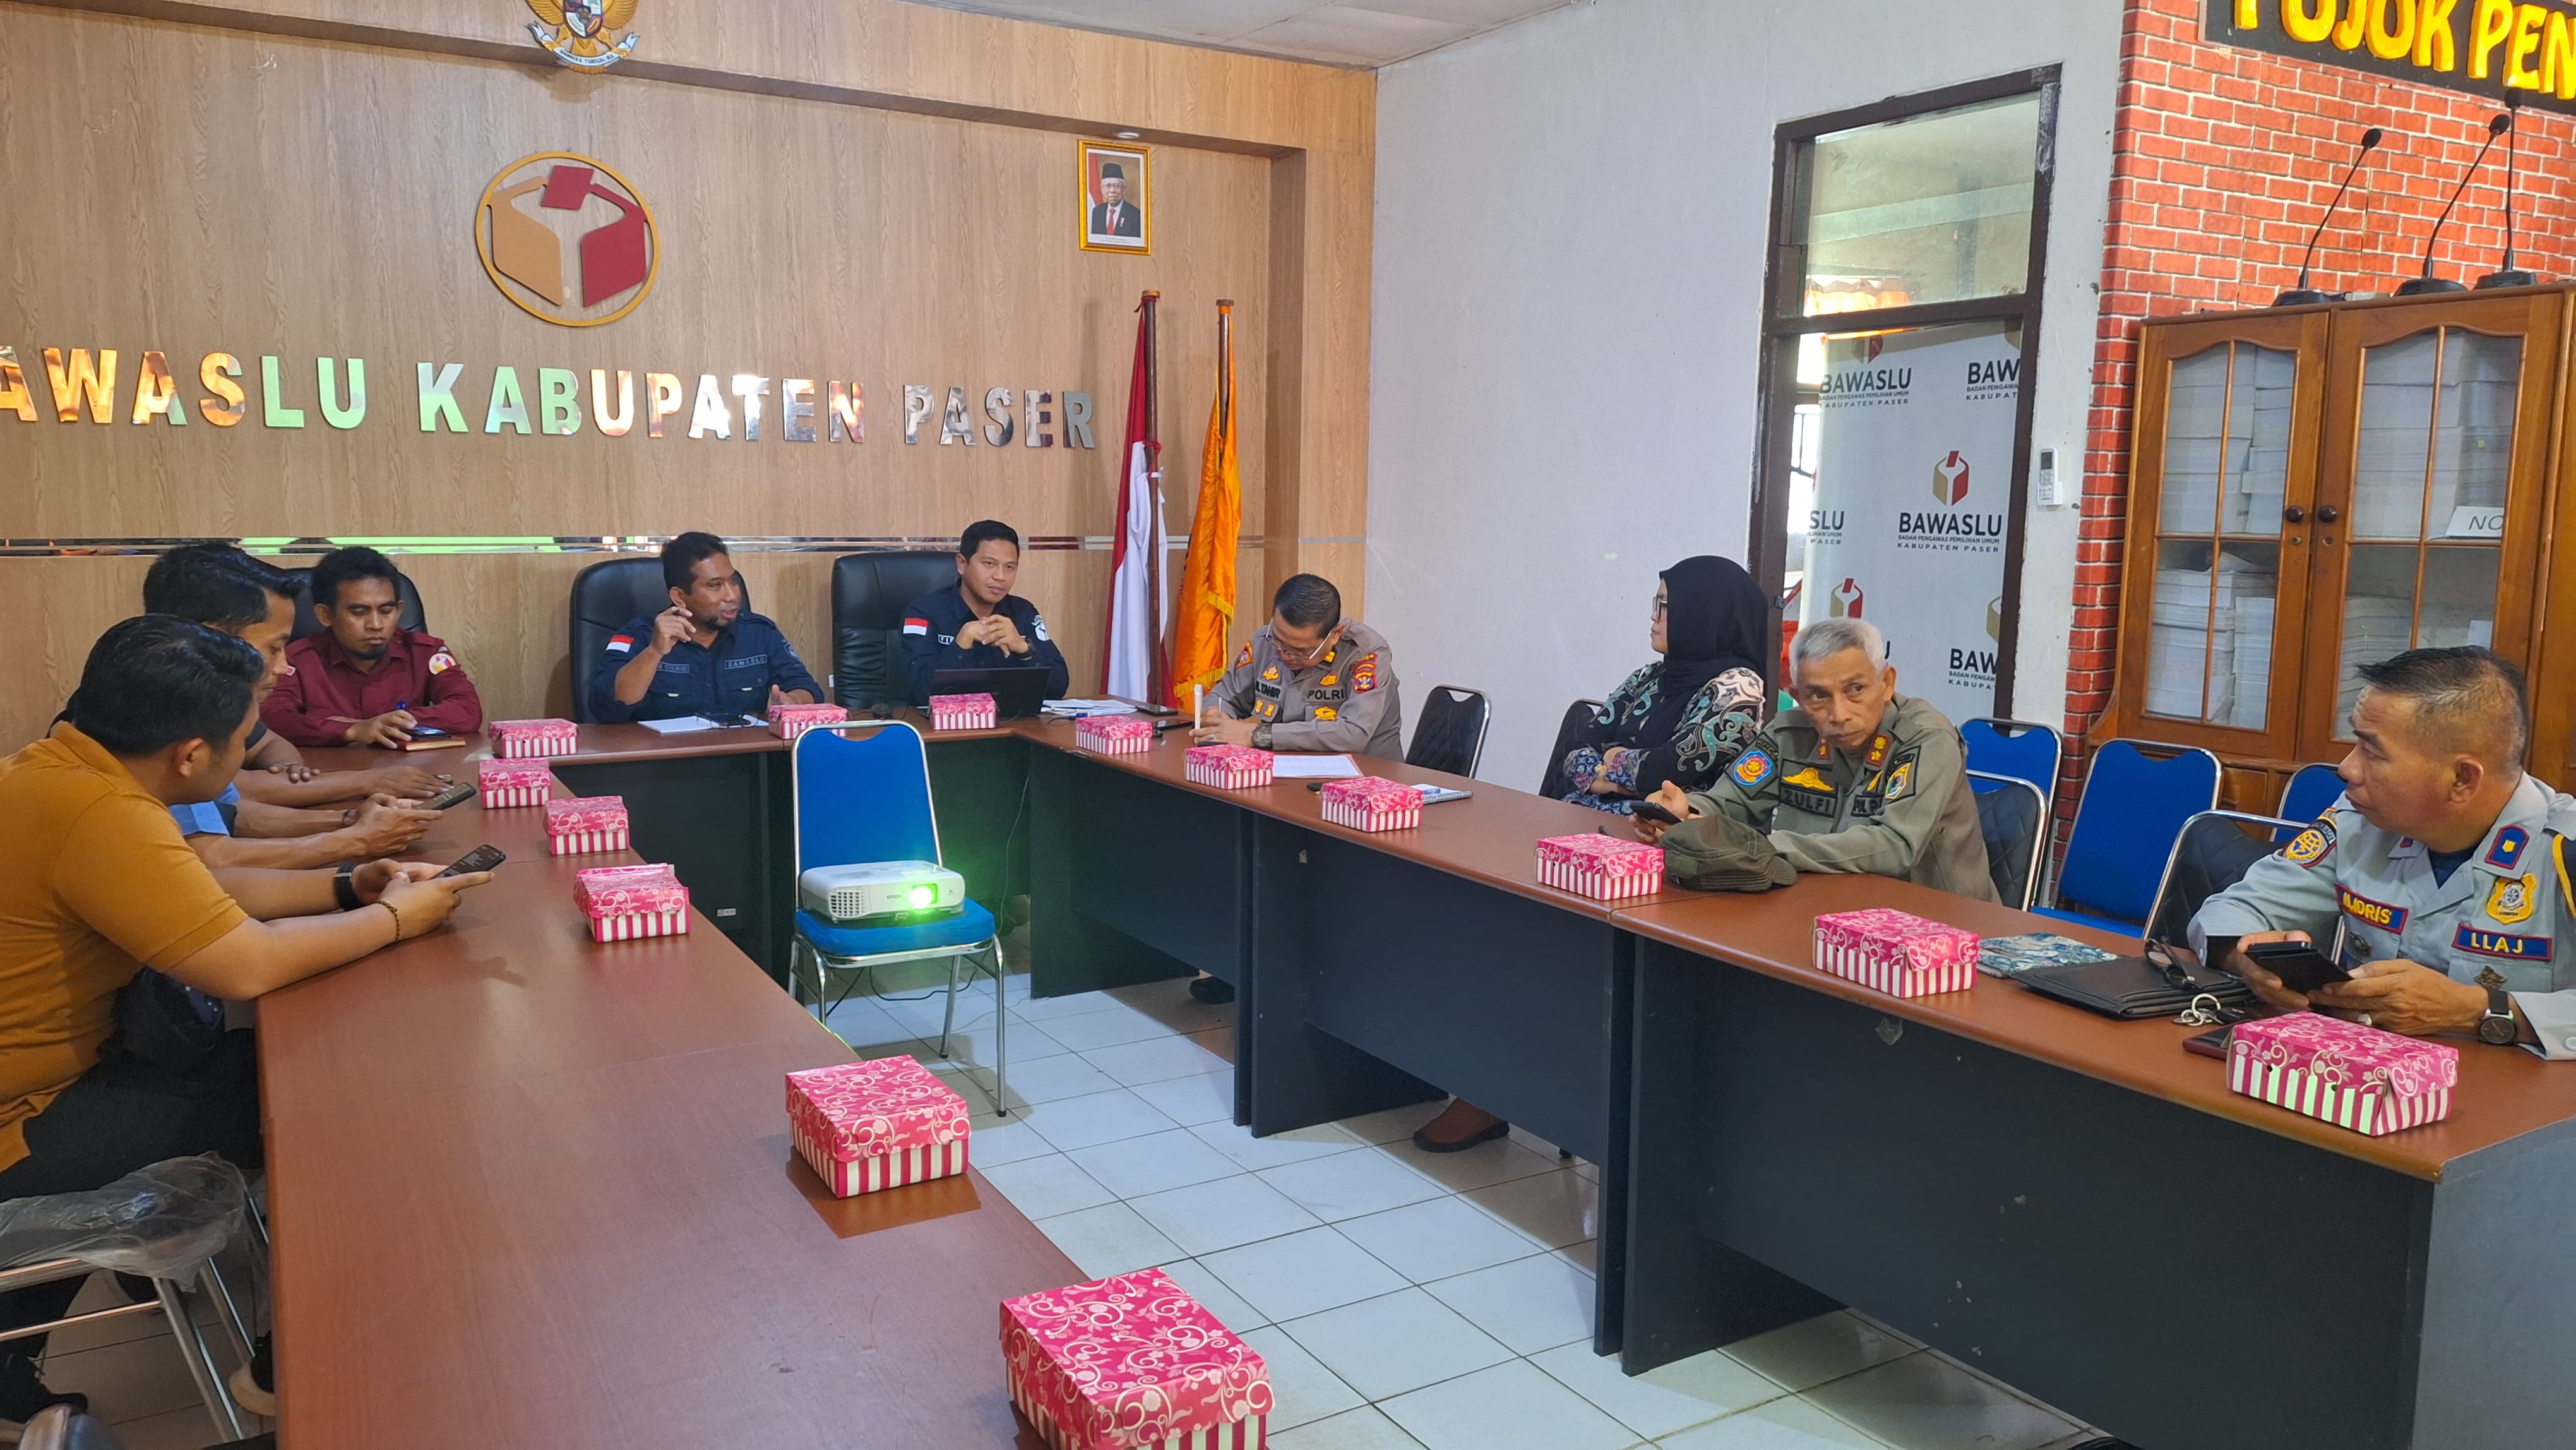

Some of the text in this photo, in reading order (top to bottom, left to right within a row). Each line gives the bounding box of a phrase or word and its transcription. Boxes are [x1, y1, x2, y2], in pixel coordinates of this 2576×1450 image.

[1820, 368, 1912, 393] BAWASLU
[1967, 358, 2020, 384] BAW
[417, 362, 865, 443] KABUPATEN
[903, 384, 1095, 449] PASER
[1965, 392, 2017, 400] KABUPAT
[1810, 510, 1844, 530] SLU
[1899, 512, 2002, 536] BAWASLU
[1897, 542, 1959, 551] KABUPATEN
[1950, 648, 1996, 674] BAW
[1307, 688, 1345, 700] POLRI
[1948, 679, 1995, 690] KABUPA
[1783, 789, 1830, 812] ZULFI
[2471, 932, 2523, 954] LLAJ
